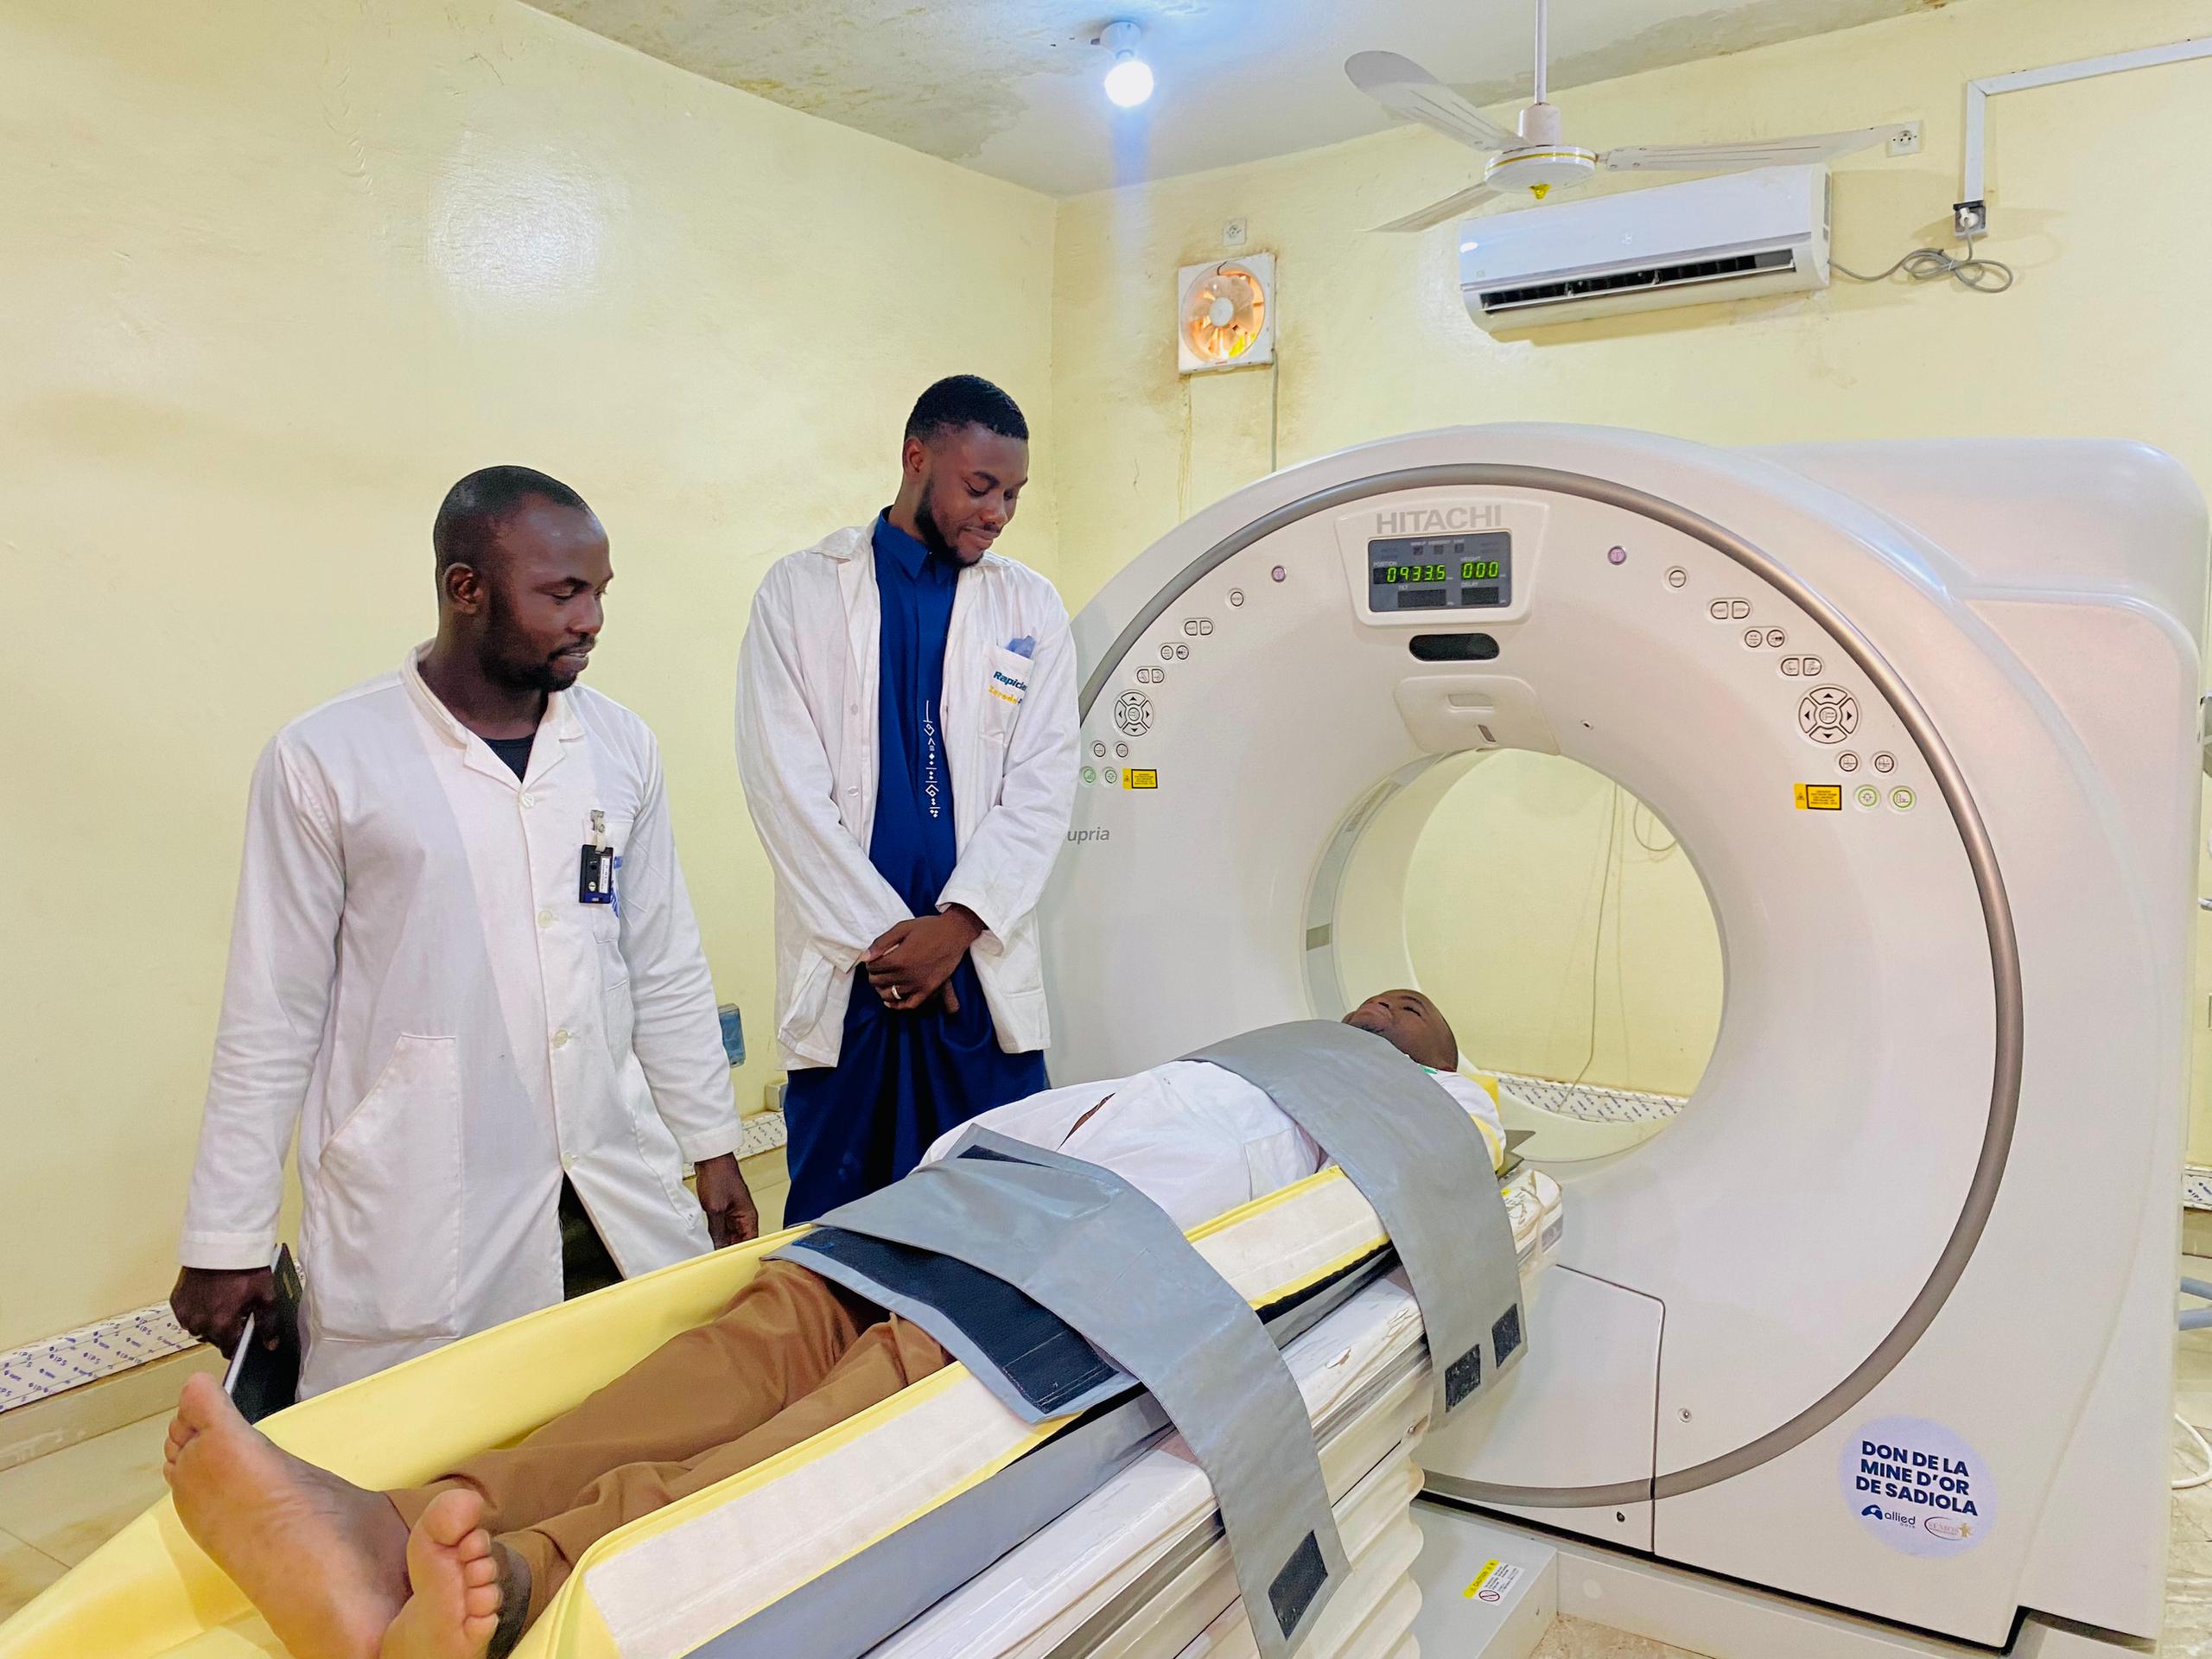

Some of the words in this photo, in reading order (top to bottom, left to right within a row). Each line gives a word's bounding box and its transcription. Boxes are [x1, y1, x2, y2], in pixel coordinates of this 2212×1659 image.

[1376, 505, 1502, 534] HITACHI
[1462, 562, 1499, 579] 000
[1067, 826, 1110, 845] upria
[1862, 1440, 1908, 1464] DON
[1912, 1451, 1939, 1471] DE
[1943, 1458, 1970, 1477] LA
[1860, 1459, 1912, 1484] MINE
[1856, 1476, 1882, 1495] DE
[1885, 1482, 1979, 1516] SADIOLA
[1885, 1511, 1916, 1525] allied
